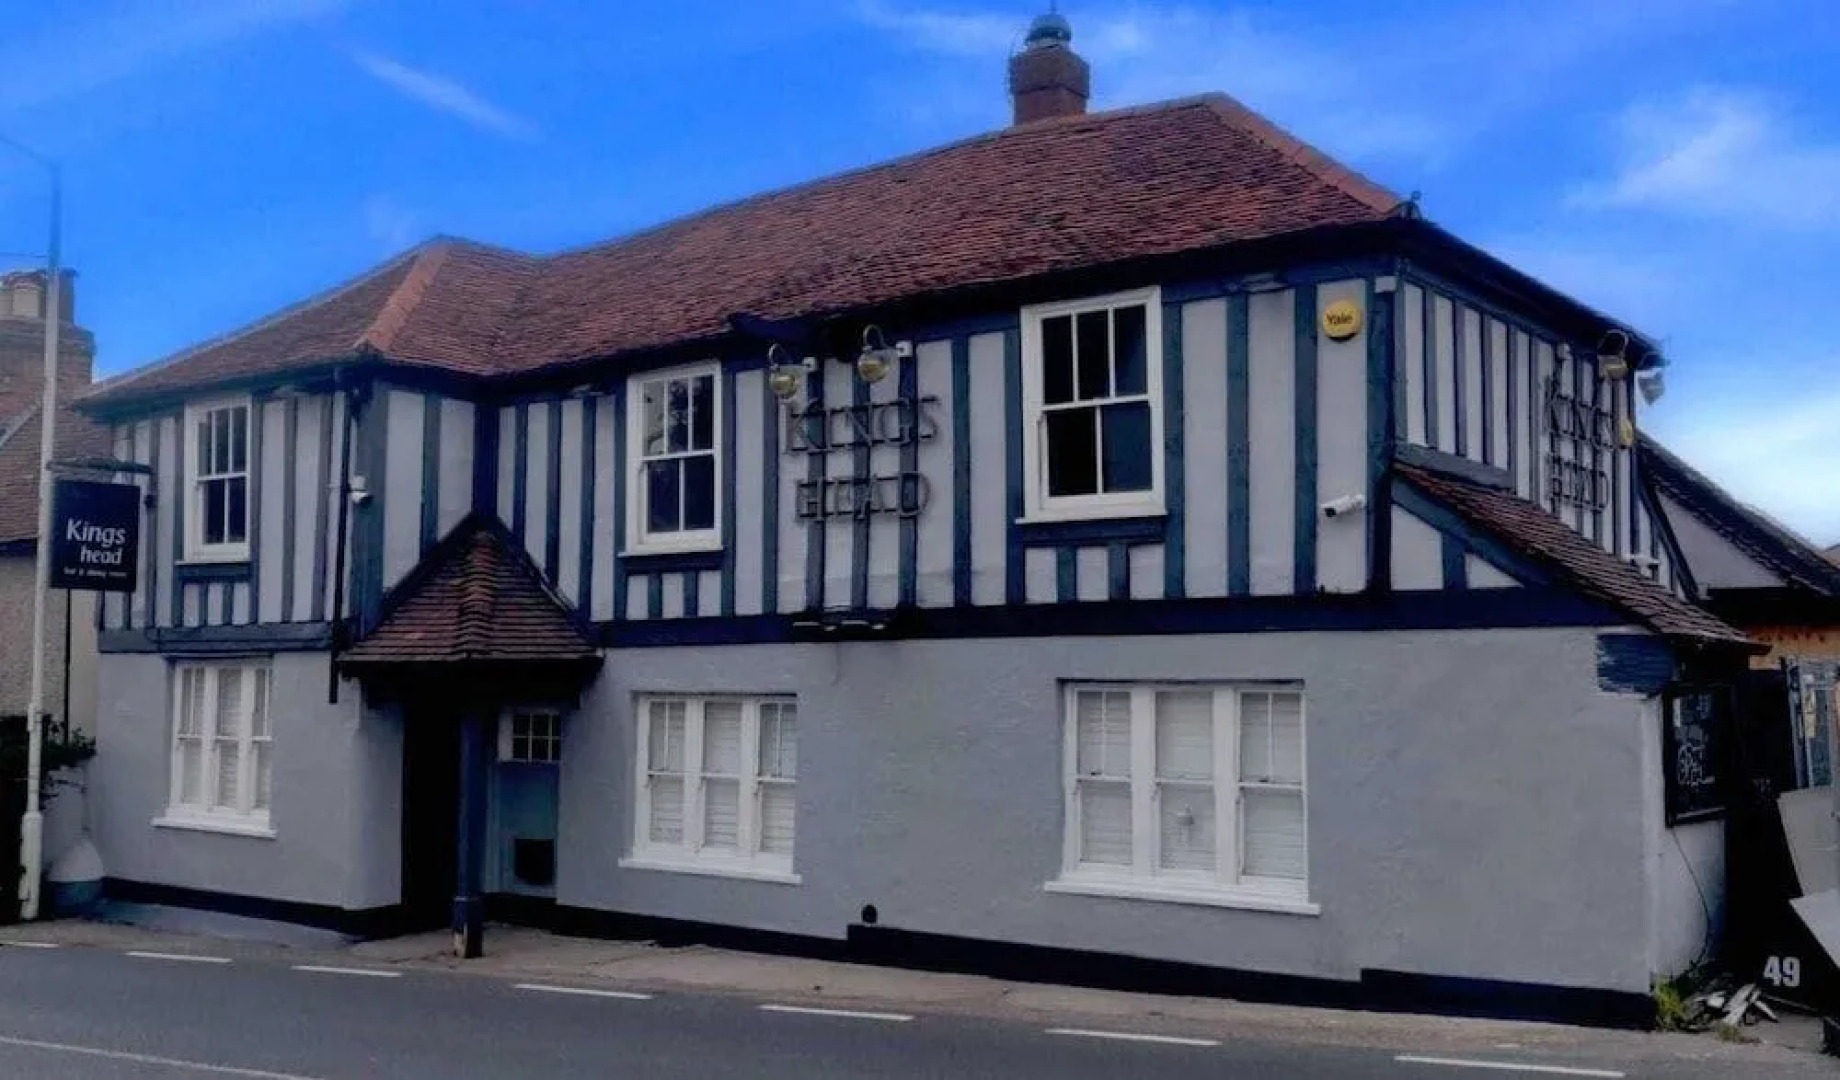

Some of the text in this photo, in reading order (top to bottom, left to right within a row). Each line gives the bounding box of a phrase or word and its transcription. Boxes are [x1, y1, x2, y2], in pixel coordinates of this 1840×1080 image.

[784, 396, 942, 455] KINGS
[795, 470, 931, 521] HEAD
[66, 518, 126, 547] Kings
[80, 545, 122, 564] head
[1763, 956, 1800, 987] 49
